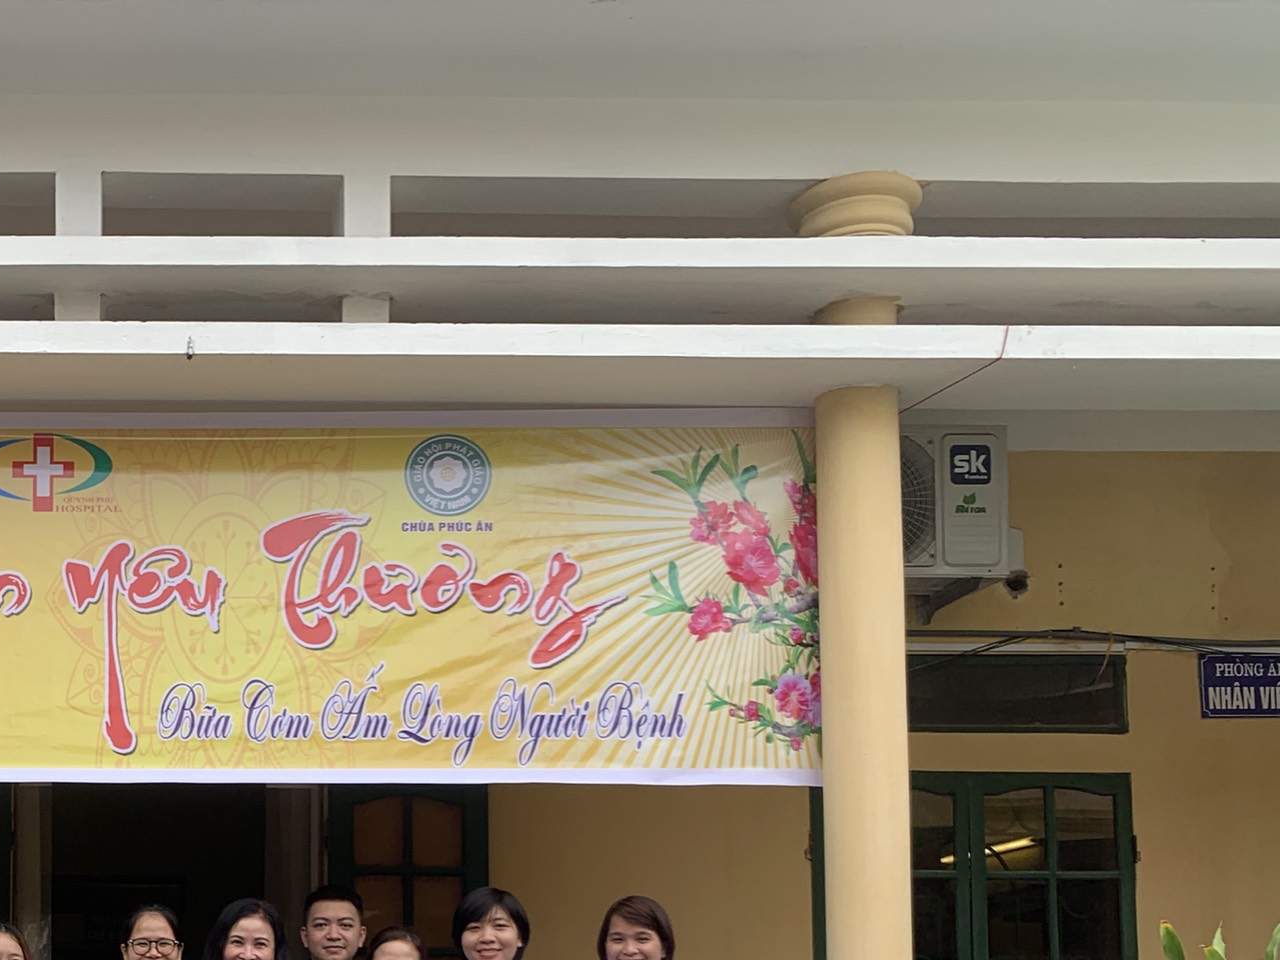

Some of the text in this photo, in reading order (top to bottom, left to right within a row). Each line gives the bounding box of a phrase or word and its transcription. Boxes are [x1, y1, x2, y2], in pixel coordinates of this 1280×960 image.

[55, 505, 122, 513] HOSPITAL
[447, 494, 472, 511] NAM
[401, 520, 435, 532] CHÙA
[438, 520, 473, 532] PHÚC
[1214, 657, 1280, 677] PHÒNG Ă
[1207, 681, 1256, 710] NHÂN
[157, 660, 687, 767] Bữa Cơm Ấm Lòng Người Bệnh
